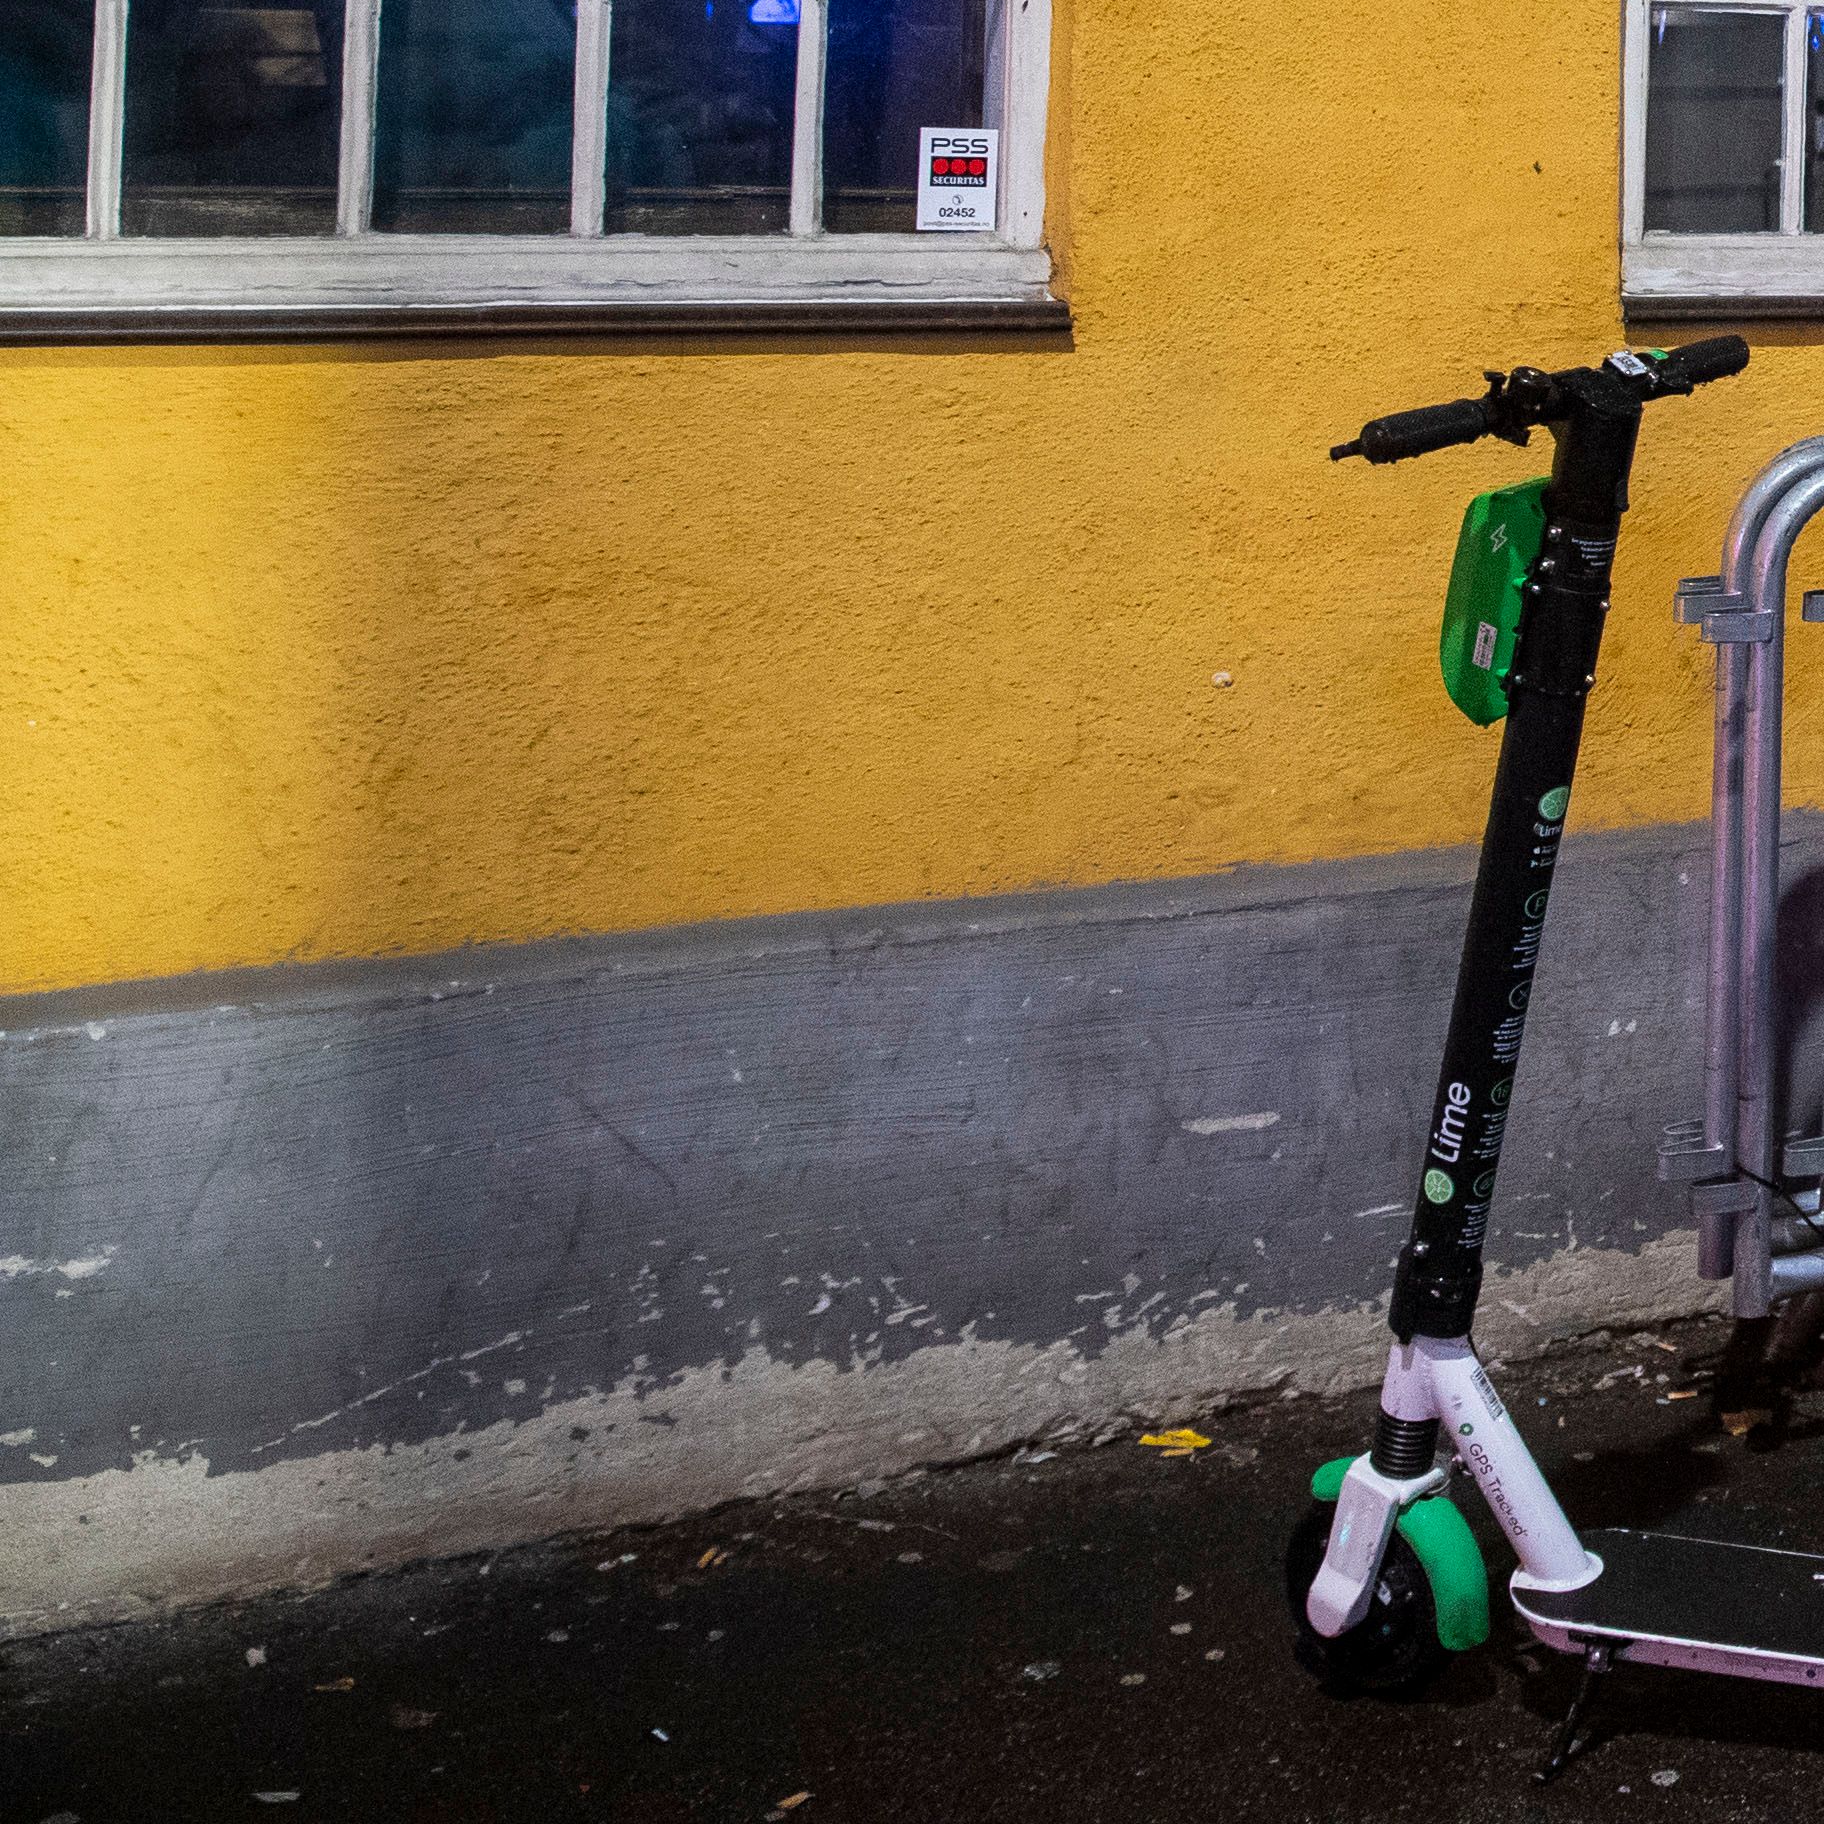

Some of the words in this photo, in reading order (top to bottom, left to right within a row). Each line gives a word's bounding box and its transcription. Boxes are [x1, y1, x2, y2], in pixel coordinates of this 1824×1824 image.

[931, 137, 989, 154] PSS
[932, 176, 985, 186] SECURITAS
[938, 207, 976, 219] 02452
[1431, 1082, 1472, 1163] Lime
[1469, 1443, 1494, 1476] GPS
[1488, 1477, 1526, 1537] Tracked
